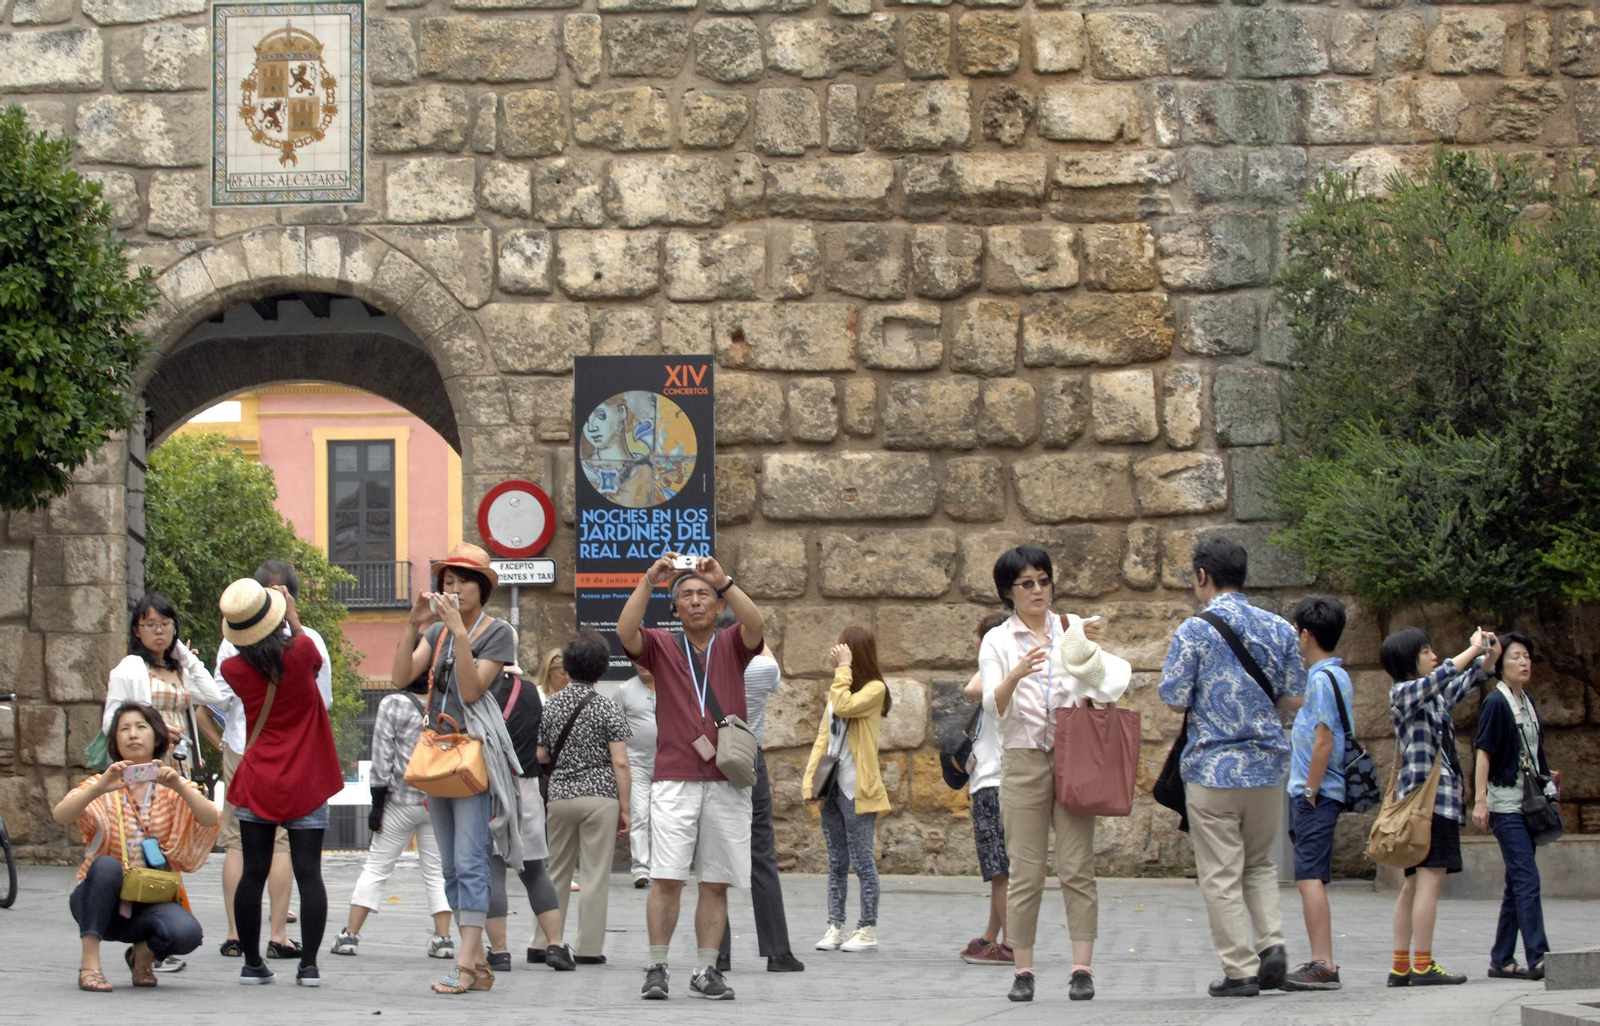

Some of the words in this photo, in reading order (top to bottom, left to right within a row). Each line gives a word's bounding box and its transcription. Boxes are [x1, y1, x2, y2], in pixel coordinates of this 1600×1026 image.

[231, 173, 276, 187] REALES
[664, 364, 708, 387] XIV
[663, 387, 709, 396] CONCIERTOS
[582, 508, 648, 524] NOCHES
[652, 508, 671, 523] EN
[675, 508, 709, 523] LOS
[579, 523, 673, 541] JARDINES
[677, 523, 711, 540] DEL
[580, 543, 621, 559] REAL
[500, 562, 534, 570] EXCEPTO
[537, 572, 554, 580] TAXI
[580, 576, 591, 584] 19
[593, 576, 604, 584] de
[606, 576, 628, 585] junio
[631, 576, 639, 584] al
